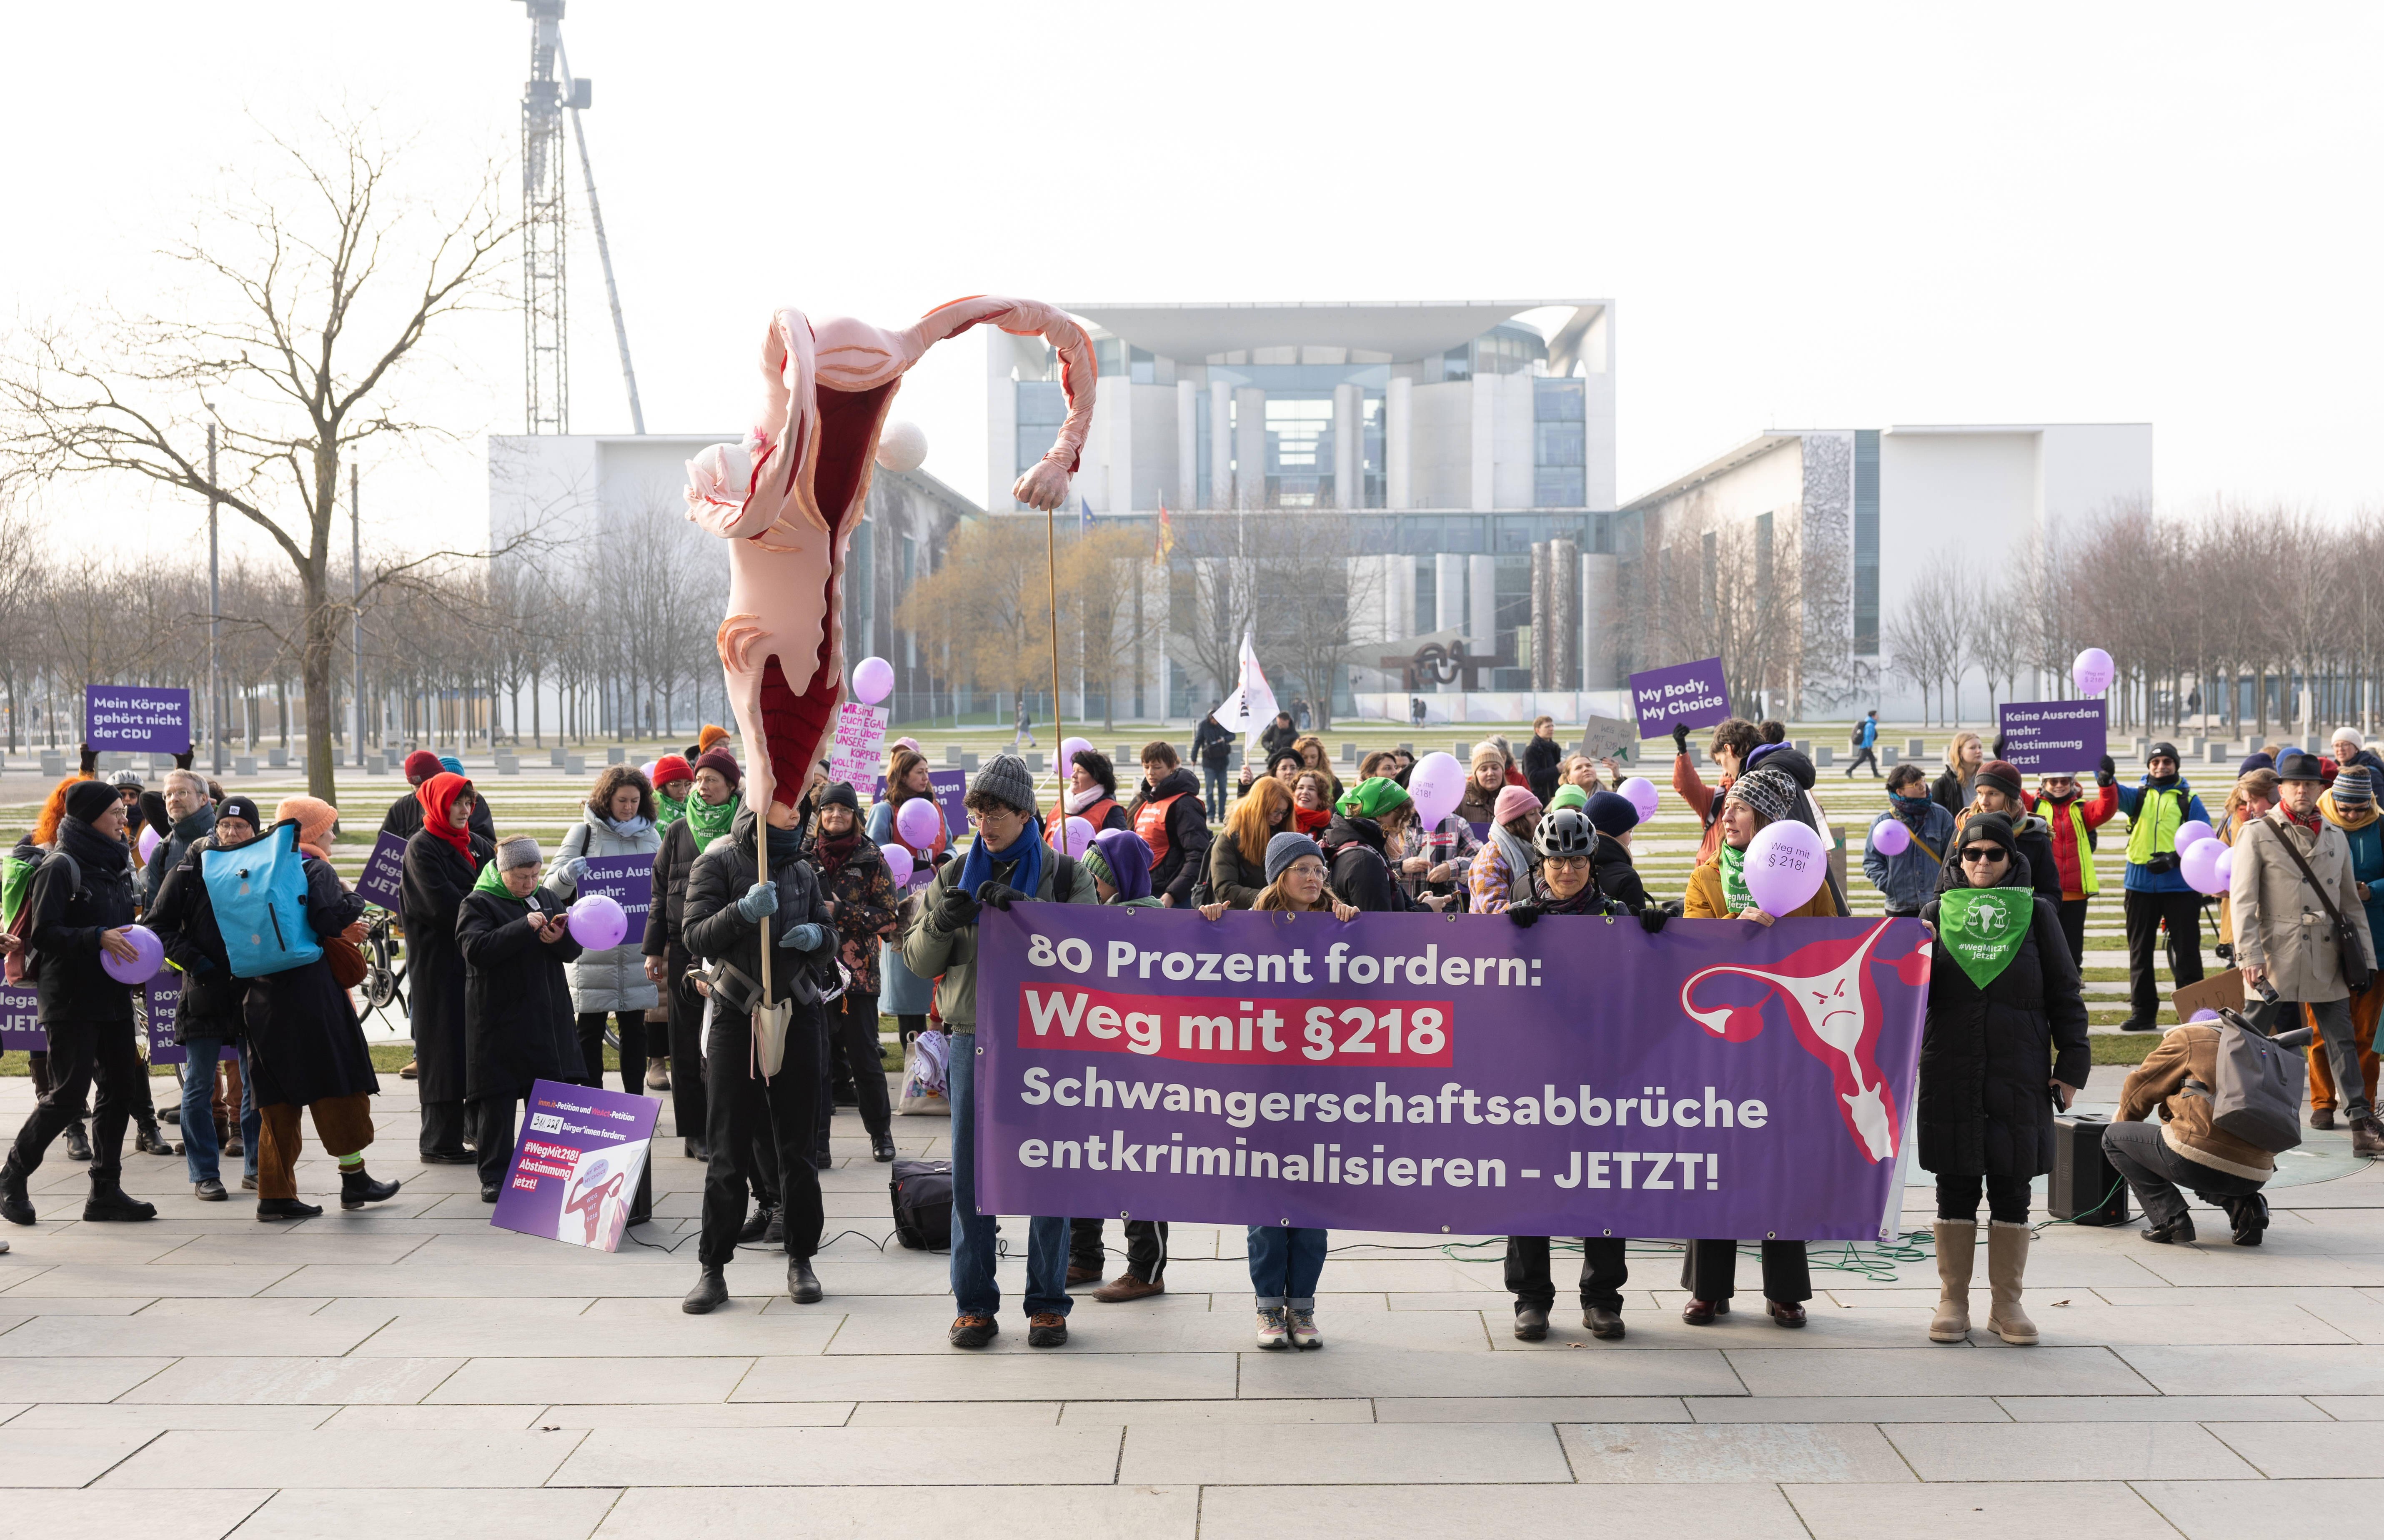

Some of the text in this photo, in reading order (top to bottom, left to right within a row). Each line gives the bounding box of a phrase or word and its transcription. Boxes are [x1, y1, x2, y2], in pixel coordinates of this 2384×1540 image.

[1639, 679, 1709, 702] My Body,
[94, 697, 181, 712] Mein Körper
[842, 702, 874, 717] WIR sind
[1643, 695, 1723, 720] My Choice
[94, 712, 182, 725] gehört nicht
[2006, 708, 2099, 722] Keine Ausreden
[841, 715, 886, 730] euch EGAL
[94, 727, 152, 740] der CDU
[838, 725, 882, 740] aber über
[2006, 726, 2041, 736] mehr:
[835, 735, 868, 748] UNSERE
[2007, 740, 2083, 750] Abstimmung
[850, 748, 881, 762] KÖRPER
[2007, 755, 2040, 765] jetzt!
[855, 759, 866, 770] ihr
[831, 767, 871, 782] trotzdem
[1415, 788, 1431, 798] 218!
[1771, 842, 1811, 859] Weg mit
[375, 858, 403, 878] lega
[1768, 854, 1806, 872] § 218!
[584, 868, 624, 880] Keine
[367, 876, 400, 899] JET
[585, 885, 625, 897] mehr:
[1728, 900, 1750, 909] Jetzt!
[1968, 896, 1980, 906] legal,
[1998, 898, 2006, 907] fair
[1028, 934, 1541, 986] 80 Prozent fordern:
[1972, 951, 1996, 960] Jetzt!
[0, 992, 38, 1009] lega
[1025, 990, 1445, 1060] Weg mit §218
[1021, 1067, 1768, 1128] Schwangerschaftsabbrüche
[591, 1107, 635, 1122] WeAct-Petition
[601, 1129, 626, 1141] fordern:
[524, 1141, 579, 1161] #WegMit218!
[593, 1162, 604, 1172] BODY
[1019, 1130, 1506, 1187] entkriminalisieren
[1554, 1152, 1718, 1190] JETZT!
[518, 1158, 571, 1181] Abstimmung
[591, 1168, 606, 1180] CHOICE
[512, 1174, 537, 1189] jetzt!
[586, 1193, 598, 1203] WEG
[588, 1202, 596, 1212] MIT
